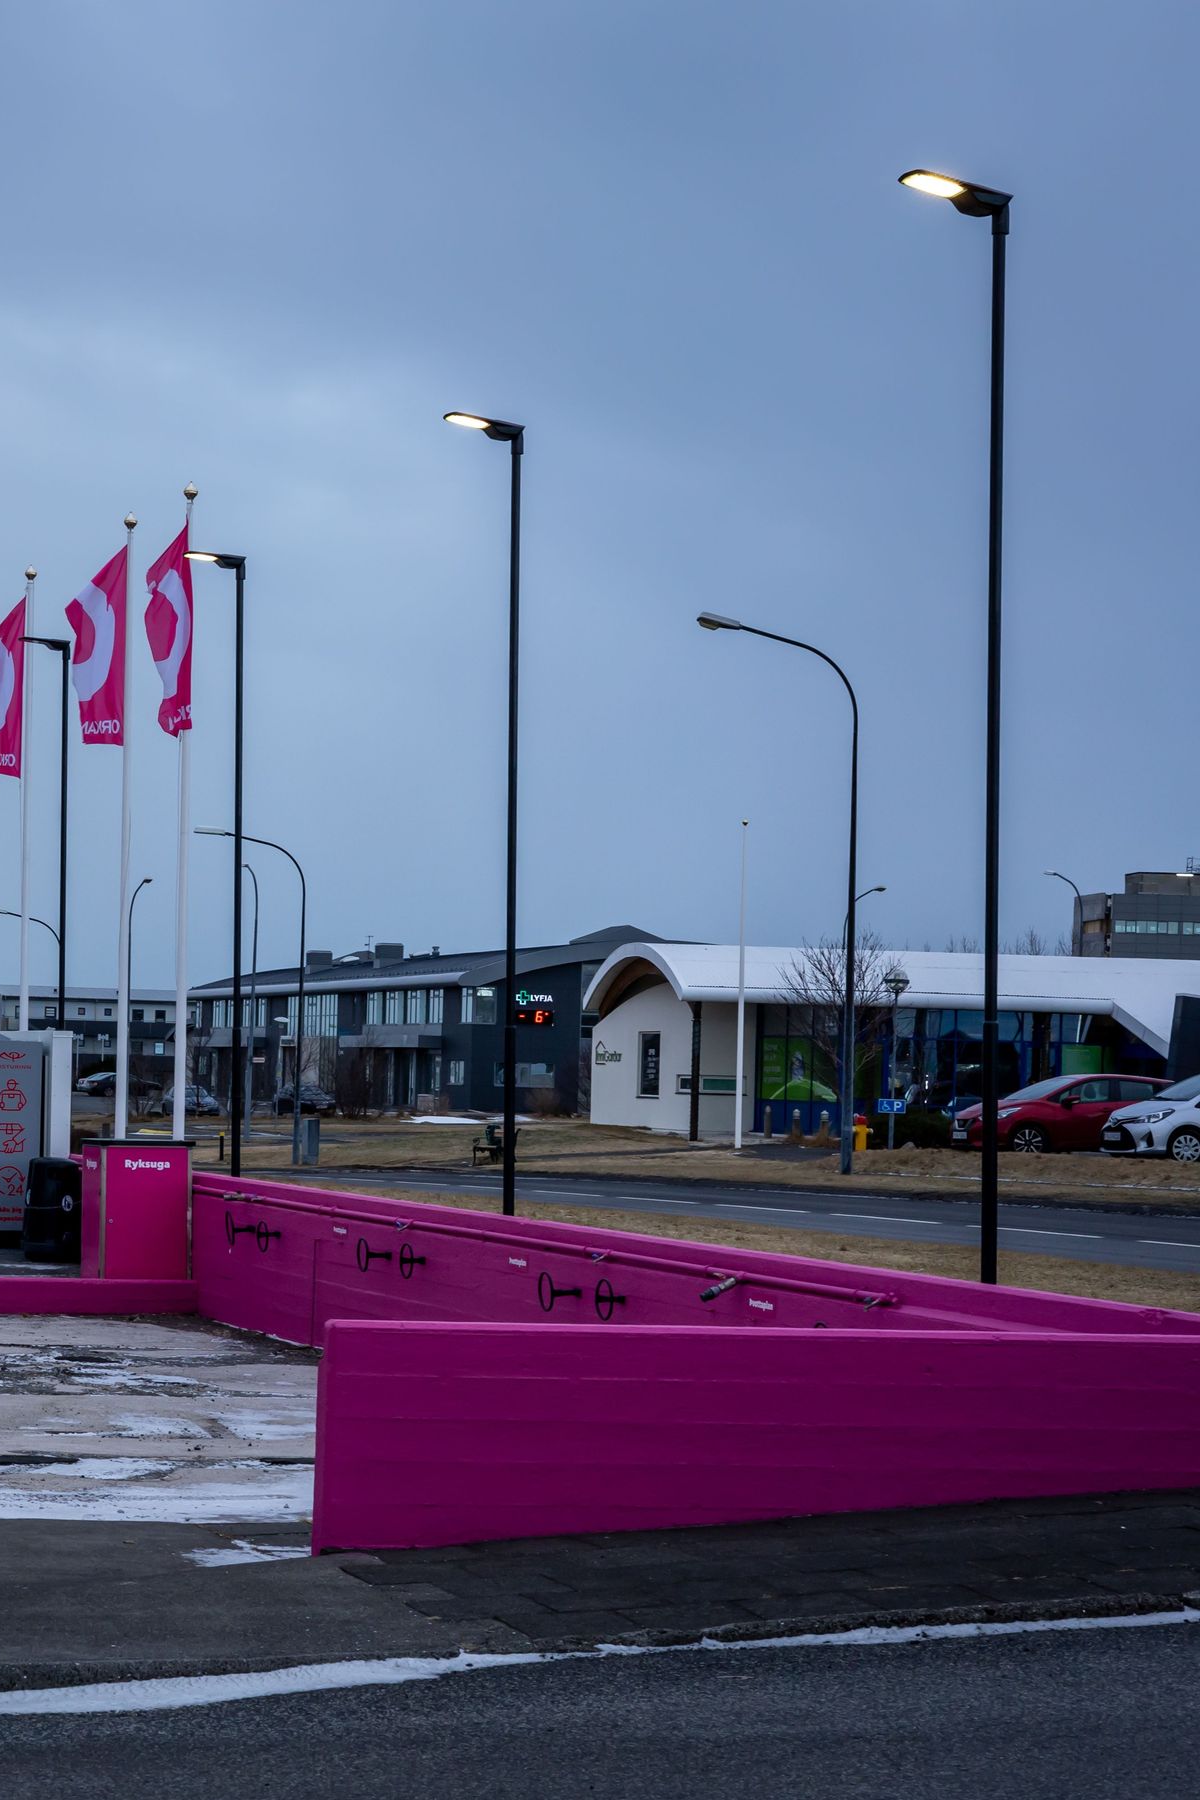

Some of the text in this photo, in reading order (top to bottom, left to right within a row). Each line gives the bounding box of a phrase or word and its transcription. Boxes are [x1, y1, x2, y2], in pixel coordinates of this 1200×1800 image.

[530, 994, 554, 1002] LYFJA
[893, 1101, 903, 1112] P
[124, 1159, 171, 1171] Ryksuga
[7, 1184, 24, 1197] 24
